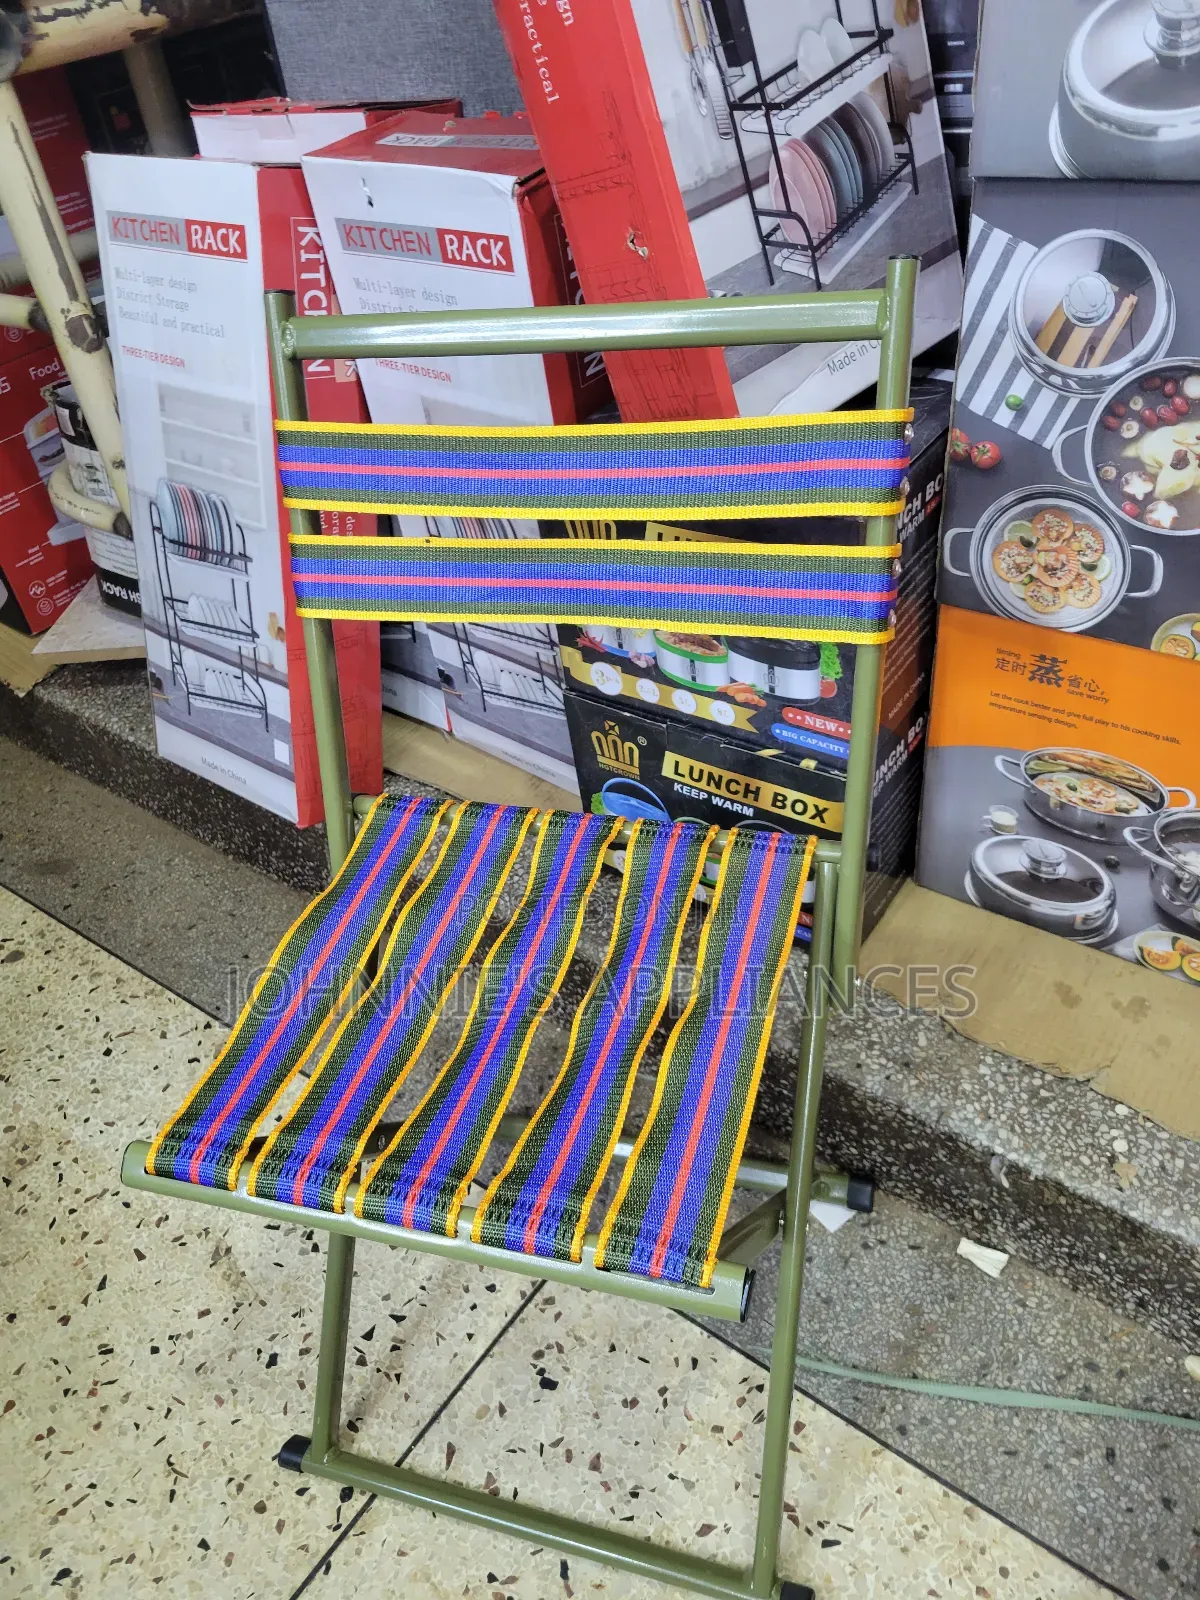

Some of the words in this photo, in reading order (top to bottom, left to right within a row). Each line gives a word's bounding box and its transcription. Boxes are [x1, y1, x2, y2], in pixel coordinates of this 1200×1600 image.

[519, 0, 560, 104] ractical
[112, 216, 180, 245] KITCHEN
[190, 224, 242, 254] RACK
[342, 223, 432, 256] KITCHEN
[444, 234, 507, 267] RACK
[114, 267, 164, 287] Multi-layer
[168, 277, 197, 293] design
[353, 276, 416, 299] Multi-layer
[421, 286, 458, 306] design
[181, 320, 225, 338] practical
[29, 359, 60, 380] Food
[375, 358, 420, 376] THREE-TIER
[421, 366, 452, 383] DESIGN
[827, 350, 857, 376] Made
[858, 343, 869, 357] in
[804, 714, 839, 732] NEW
[781, 729, 798, 740] BIG
[799, 735, 845, 753] CAPACITY
[673, 760, 761, 802] LUNCH
[771, 791, 830, 824] BOX
[674, 783, 708, 800] KEEP
[711, 796, 755, 817] WARM
